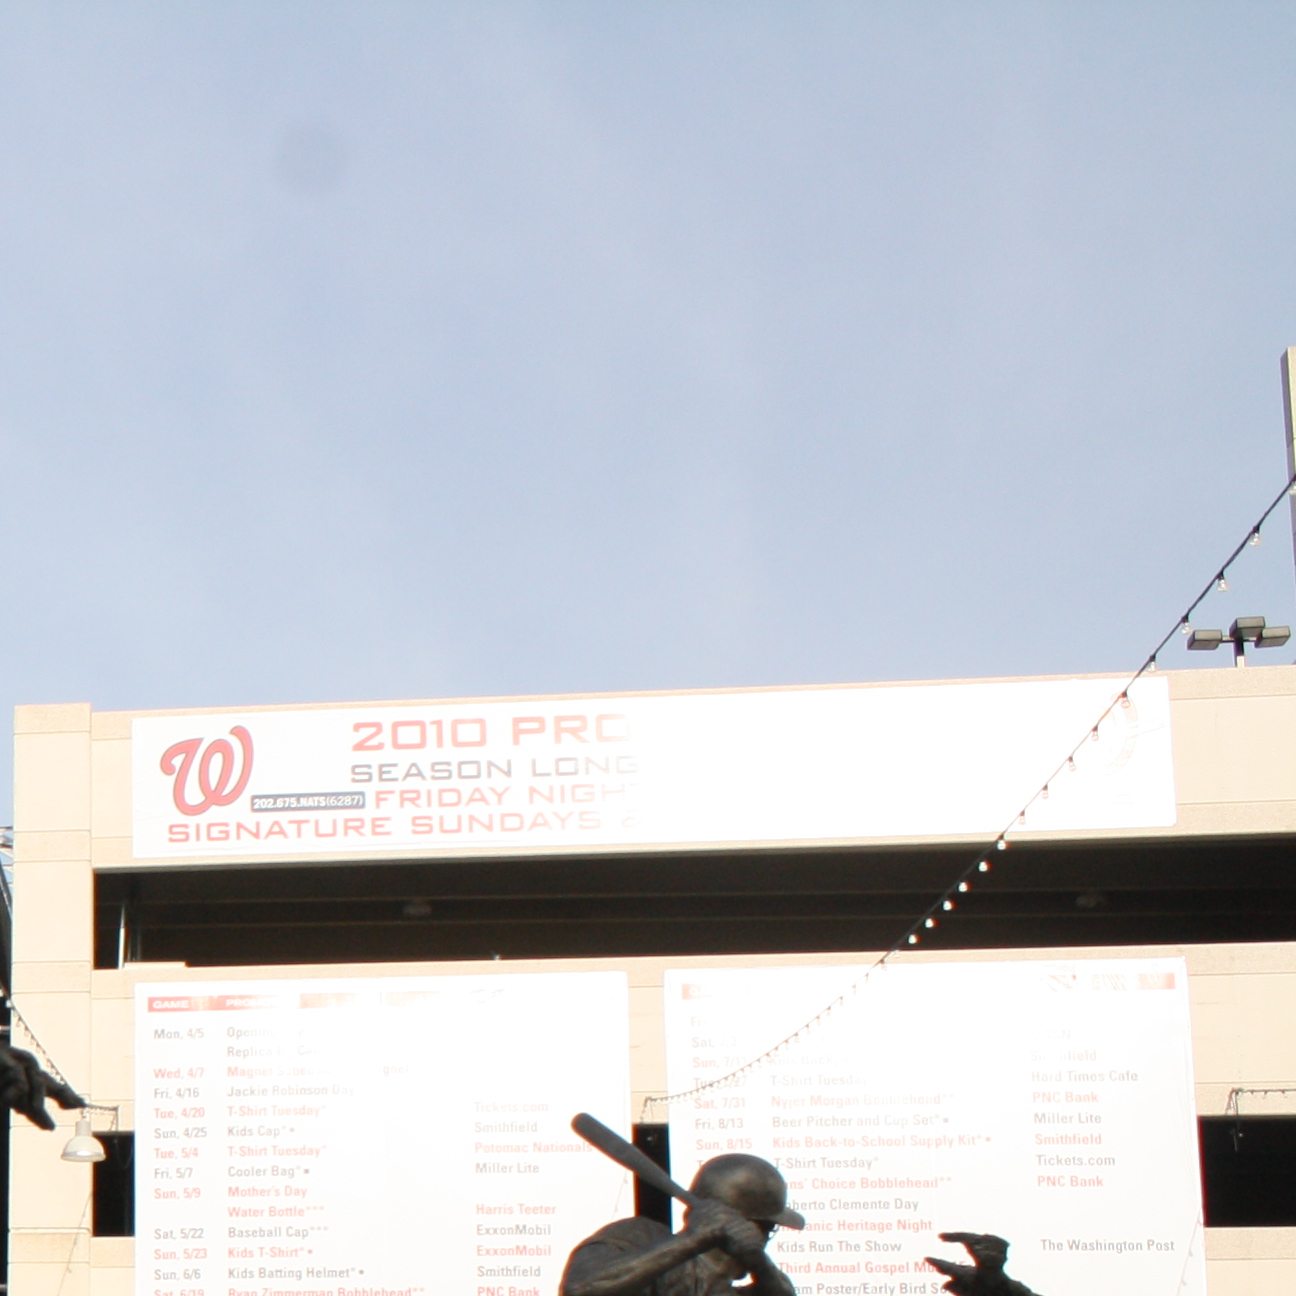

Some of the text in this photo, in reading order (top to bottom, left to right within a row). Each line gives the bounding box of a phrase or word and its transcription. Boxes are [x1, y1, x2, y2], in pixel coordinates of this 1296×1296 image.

[351, 717, 487, 752] 2010
[350, 755, 639, 783] SEASON LONG
[374, 786, 511, 809] FRIDAY
[168, 810, 602, 843] SIGNATURE SUNDAYS
[186, 1027, 206, 1040] 4/5
[186, 1066, 206, 1080] 4/7
[1030, 1068, 1140, 1083] Hard Times Cafe
[174, 1086, 200, 1100] 4/16
[226, 1084, 329, 1098] Jackie Robinson
[1032, 1090, 1100, 1104] PNC Bank
[473, 1100, 550, 1113] Tickets.com
[808, 1094, 860, 1109] Morgan
[180, 1106, 206, 1120] 4/20
[226, 1104, 268, 1118] T-Shirt
[1033, 1111, 1103, 1125] Miller Lite
[473, 1120, 539, 1134] Smithfield
[770, 1113, 909, 1129] Beer Pitcher and Cup
[182, 1126, 208, 1140] 4/25
[226, 1125, 254, 1138] Kids
[772, 1133, 955, 1150] Kids Back-to-School Supply
[1034, 1132, 1103, 1146] Smithfield
[180, 1146, 200, 1160] 5/4
[226, 1144, 268, 1158] T-Shirt
[473, 1140, 593, 1154] Potomac Nationals
[773, 1157, 817, 1170] T-Shirt
[1035, 1153, 1117, 1167] Tickets.com
[175, 1166, 194, 1180] 5/7
[226, 1165, 268, 1178] Cooler
[473, 1161, 541, 1175] Miller Lite
[812, 1177, 857, 1190] Choice
[1036, 1174, 1105, 1188] PNC Bank
[183, 1186, 202, 1200] 5/9
[226, 1184, 309, 1200] Mother's Day
[226, 1205, 265, 1218] Water
[474, 1202, 558, 1216] Harris Teeter
[829, 1197, 920, 1213] Clemente Day
[179, 1226, 205, 1240] 5/22
[226, 1225, 282, 1239] Baseball
[475, 1223, 552, 1237] ExxonMobil
[836, 1218, 933, 1234] Heritage Night
[226, 1246, 255, 1259] Kids
[475, 1243, 552, 1257] ExxonMobil
[777, 1239, 903, 1253] Kids Run The Show
[1039, 1237, 1176, 1255] The Washington Post
[182, 1247, 209, 1261] 5/23
[182, 1267, 202, 1281] 6/6
[226, 1266, 303, 1282] Kids Batting
[475, 1264, 542, 1278] Smithfield
[814, 1261, 861, 1274] Annual
[864, 1260, 910, 1277] Gospel
[816, 1281, 927, 1296] Poster/Early Bird
